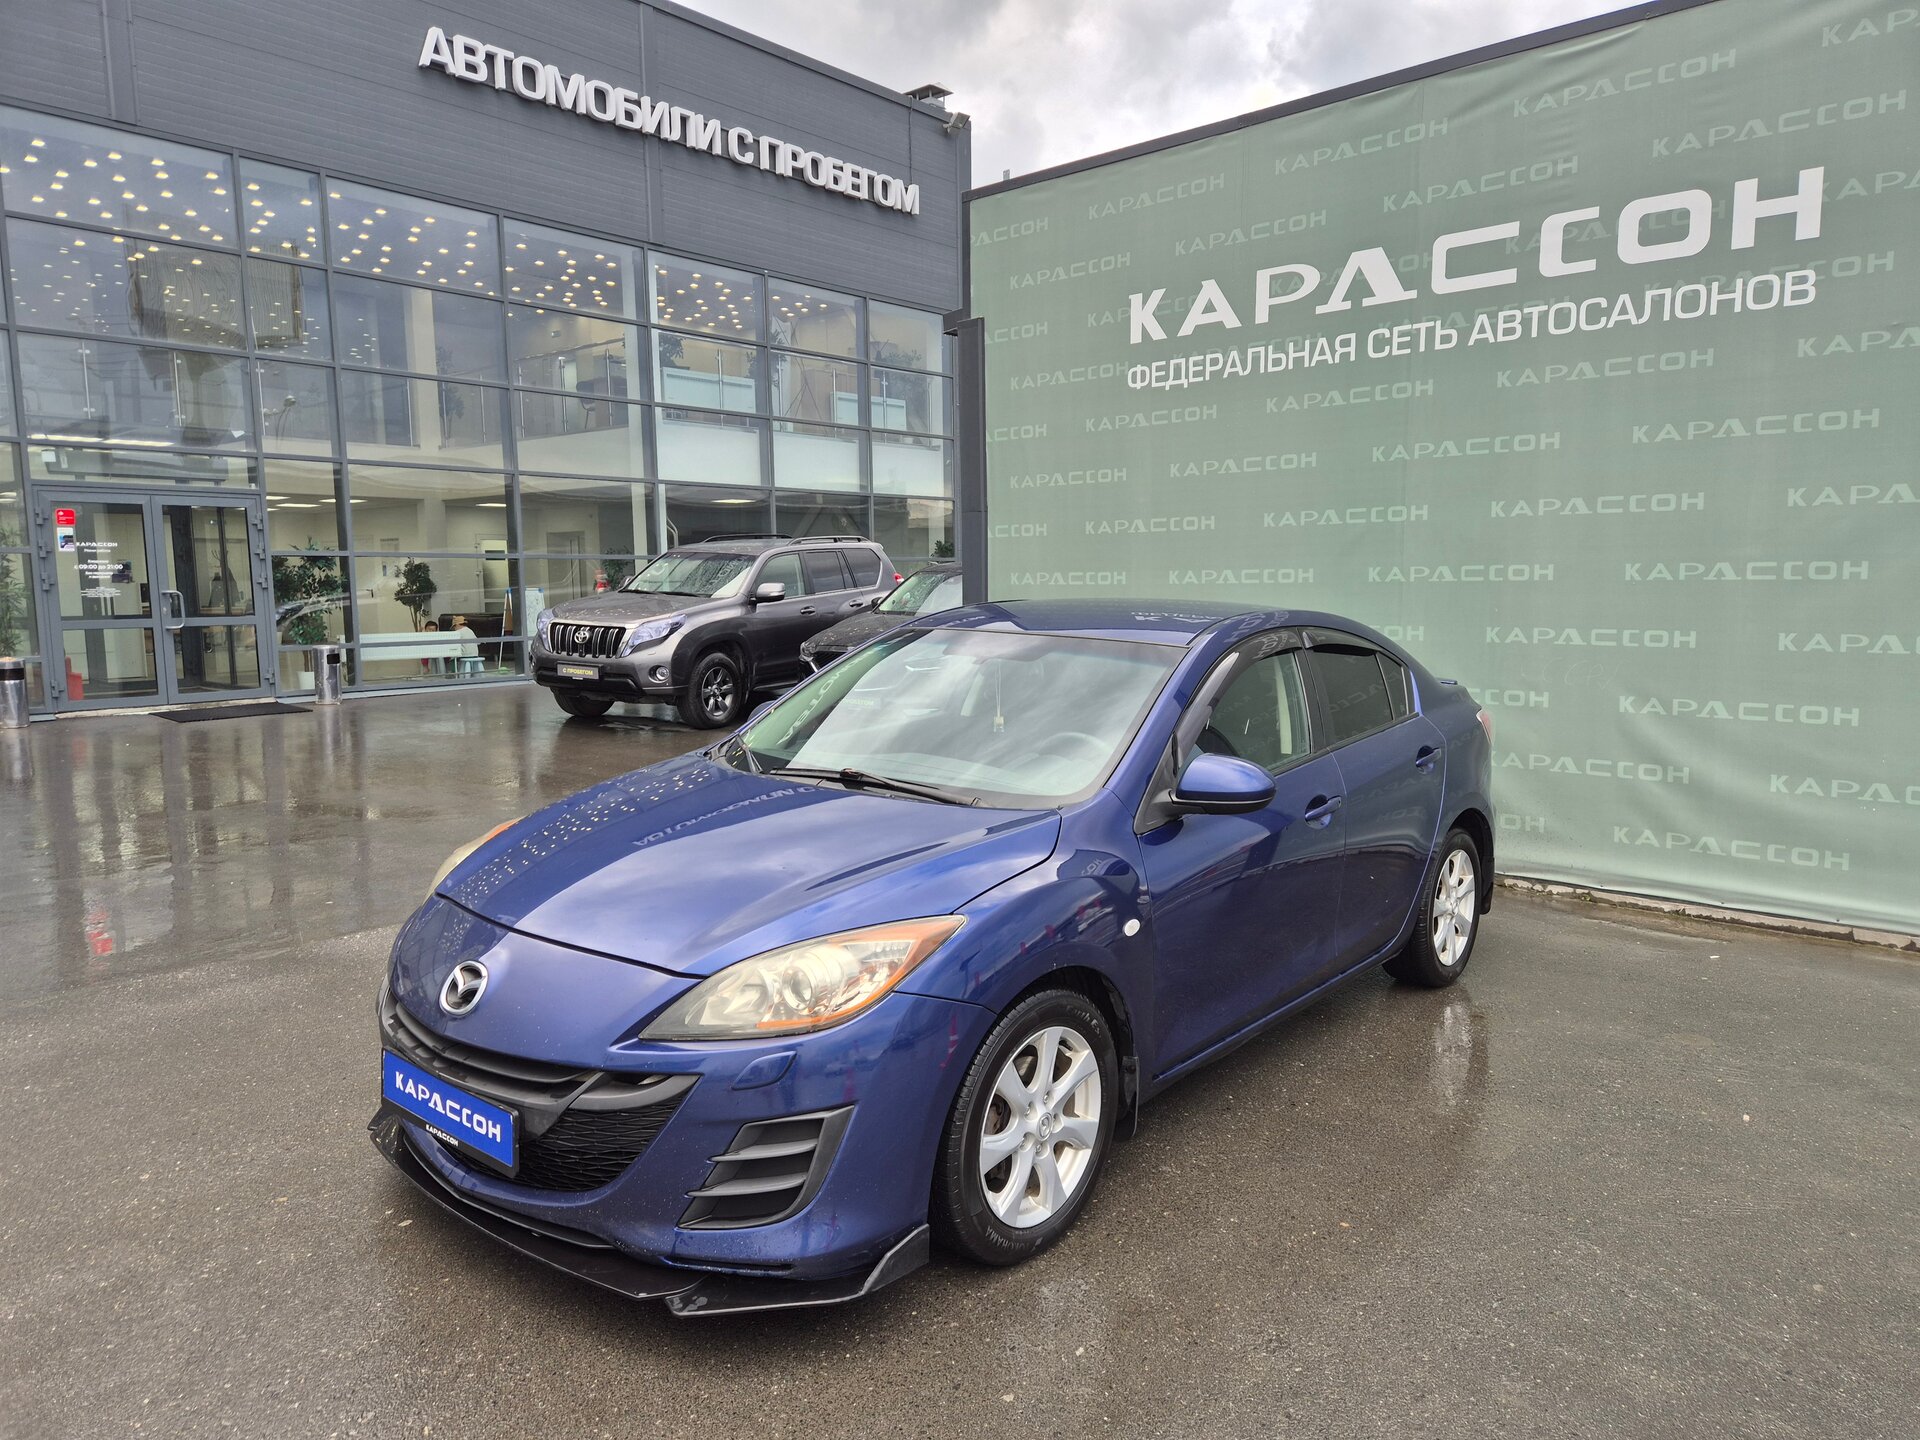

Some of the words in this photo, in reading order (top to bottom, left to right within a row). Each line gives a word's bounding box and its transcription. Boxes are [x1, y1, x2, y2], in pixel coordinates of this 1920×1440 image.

[1513, 49, 1736, 118] КАРАССОН
[418, 26, 721, 155] АВТОМОБИЛИ
[728, 127, 753, 165] С
[760, 136, 920, 215] ПРОБЕГОМ
[1652, 89, 1907, 158] КАРАССОН
[1275, 117, 1449, 176] КАРАССОН
[1088, 172, 1225, 220] КАРАССОН
[1383, 155, 1579, 213] КАРАССОН
[1175, 209, 1327, 257] КАРАССОН
[1010, 251, 1131, 290] КАРАССОН
[1129, 166, 1824, 344] КАРАССОН
[1128, 333, 1356, 391] ФЕДЕРАЛЬНАЯ
[1368, 320, 1458, 359] СЕТЬ
[1468, 269, 1816, 346] АВТОСАЛОНОВ
[1010, 360, 1129, 391] КАРАССОН
[1497, 348, 1714, 389] КАРАССОН
[1266, 379, 1434, 414] КАРАССОН
[1086, 404, 1217, 432] КАРАССОН
[1632, 408, 1880, 444] КАРАССОН
[1372, 432, 1561, 463] КАРАССОН
[1010, 467, 1127, 489] КАРАССОН
[1170, 452, 1317, 478] КАРАССОН
[1263, 504, 1429, 528] КАРАССОН
[1491, 492, 1705, 518] КАРАССОН
[1085, 515, 1215, 535] КАРАССОН
[1010, 571, 1126, 585] КАРАССОН
[1168, 568, 1314, 585] КАРАССОН
[1368, 564, 1555, 583] КАРАССОН
[1625, 561, 1869, 581] КАРАССОН
[1486, 626, 1697, 649] КАРАССОН
[1619, 695, 1859, 727] КАРАССОН
[1614, 826, 1850, 871] КАРАССОН
[395, 1071, 501, 1143] КАРАССОН
[425, 1123, 459, 1147] КАРАССОН
